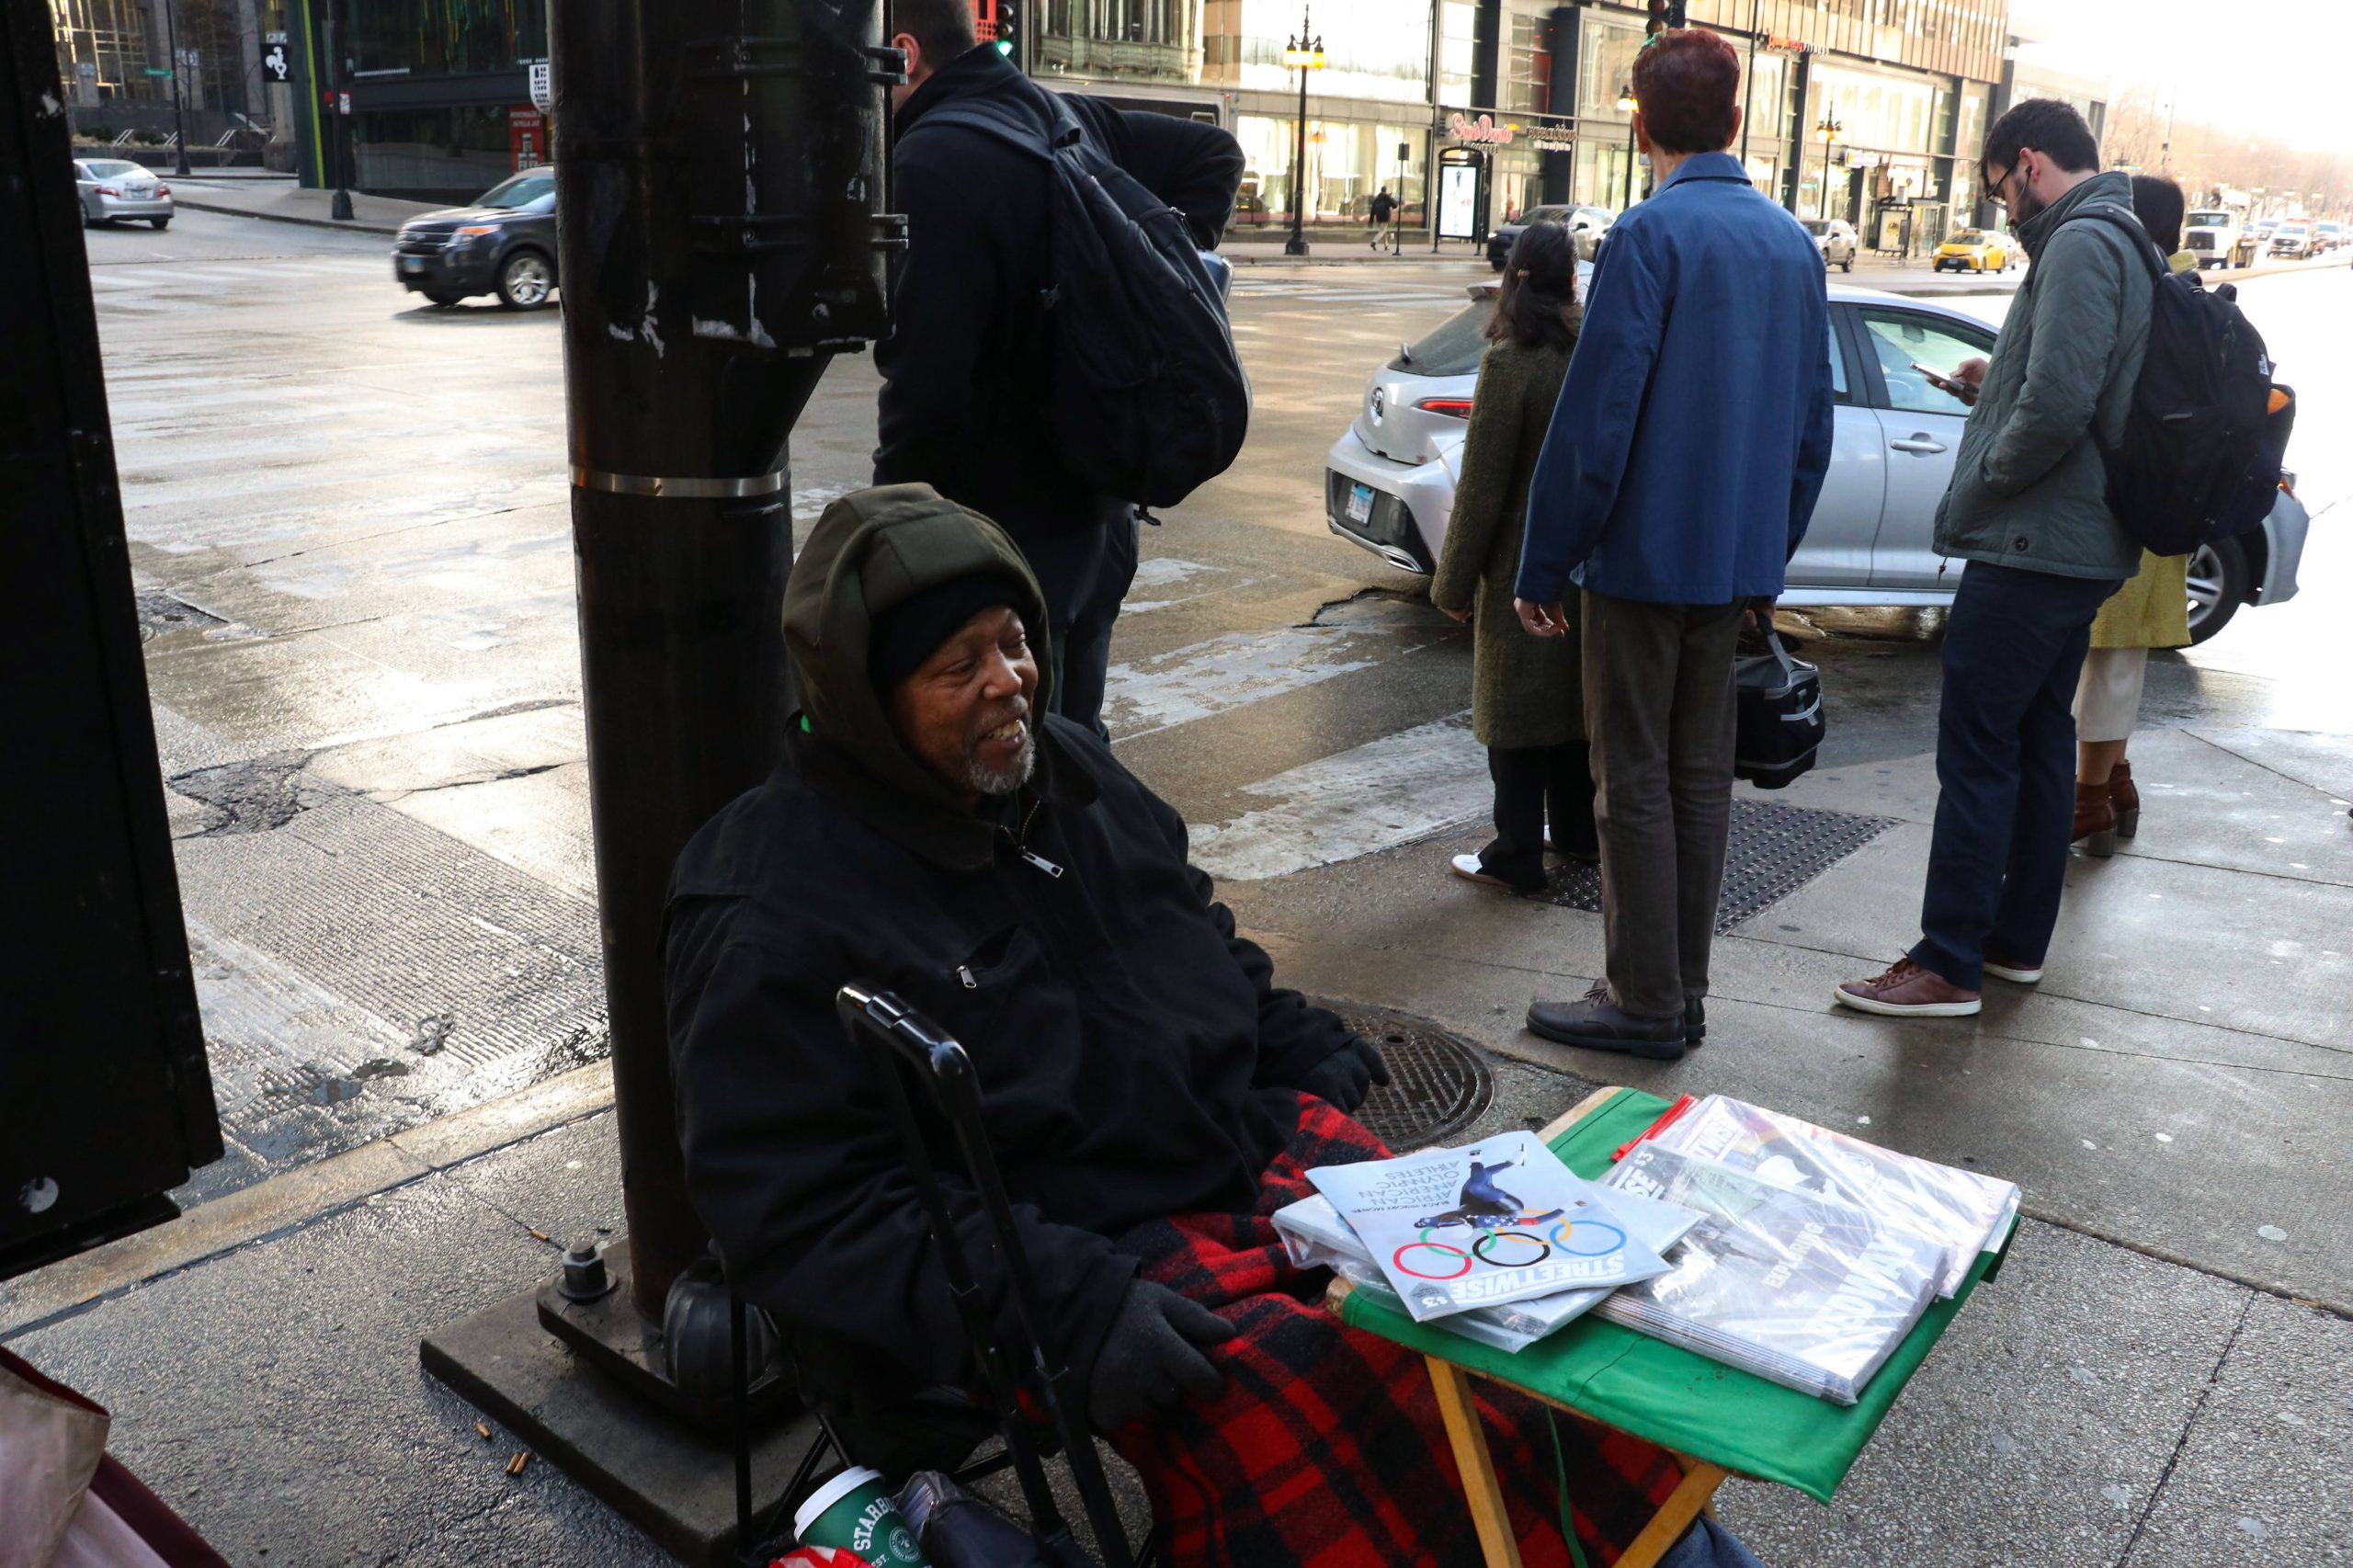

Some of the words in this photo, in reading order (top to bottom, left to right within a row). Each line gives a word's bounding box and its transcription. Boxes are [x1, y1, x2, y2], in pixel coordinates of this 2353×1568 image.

[1634, 1151, 1654, 1167] $3
[1384, 1161, 1460, 1180] ATHLETES
[1376, 1171, 1460, 1189] OLYMPIC
[1358, 1180, 1457, 1199] AMERICAN
[1370, 1189, 1452, 1206] AFRICAN
[1449, 1255, 1624, 1299] STREETWISE
[1421, 1295, 1449, 1309] $3
[853, 1496, 897, 1551] STARBU
